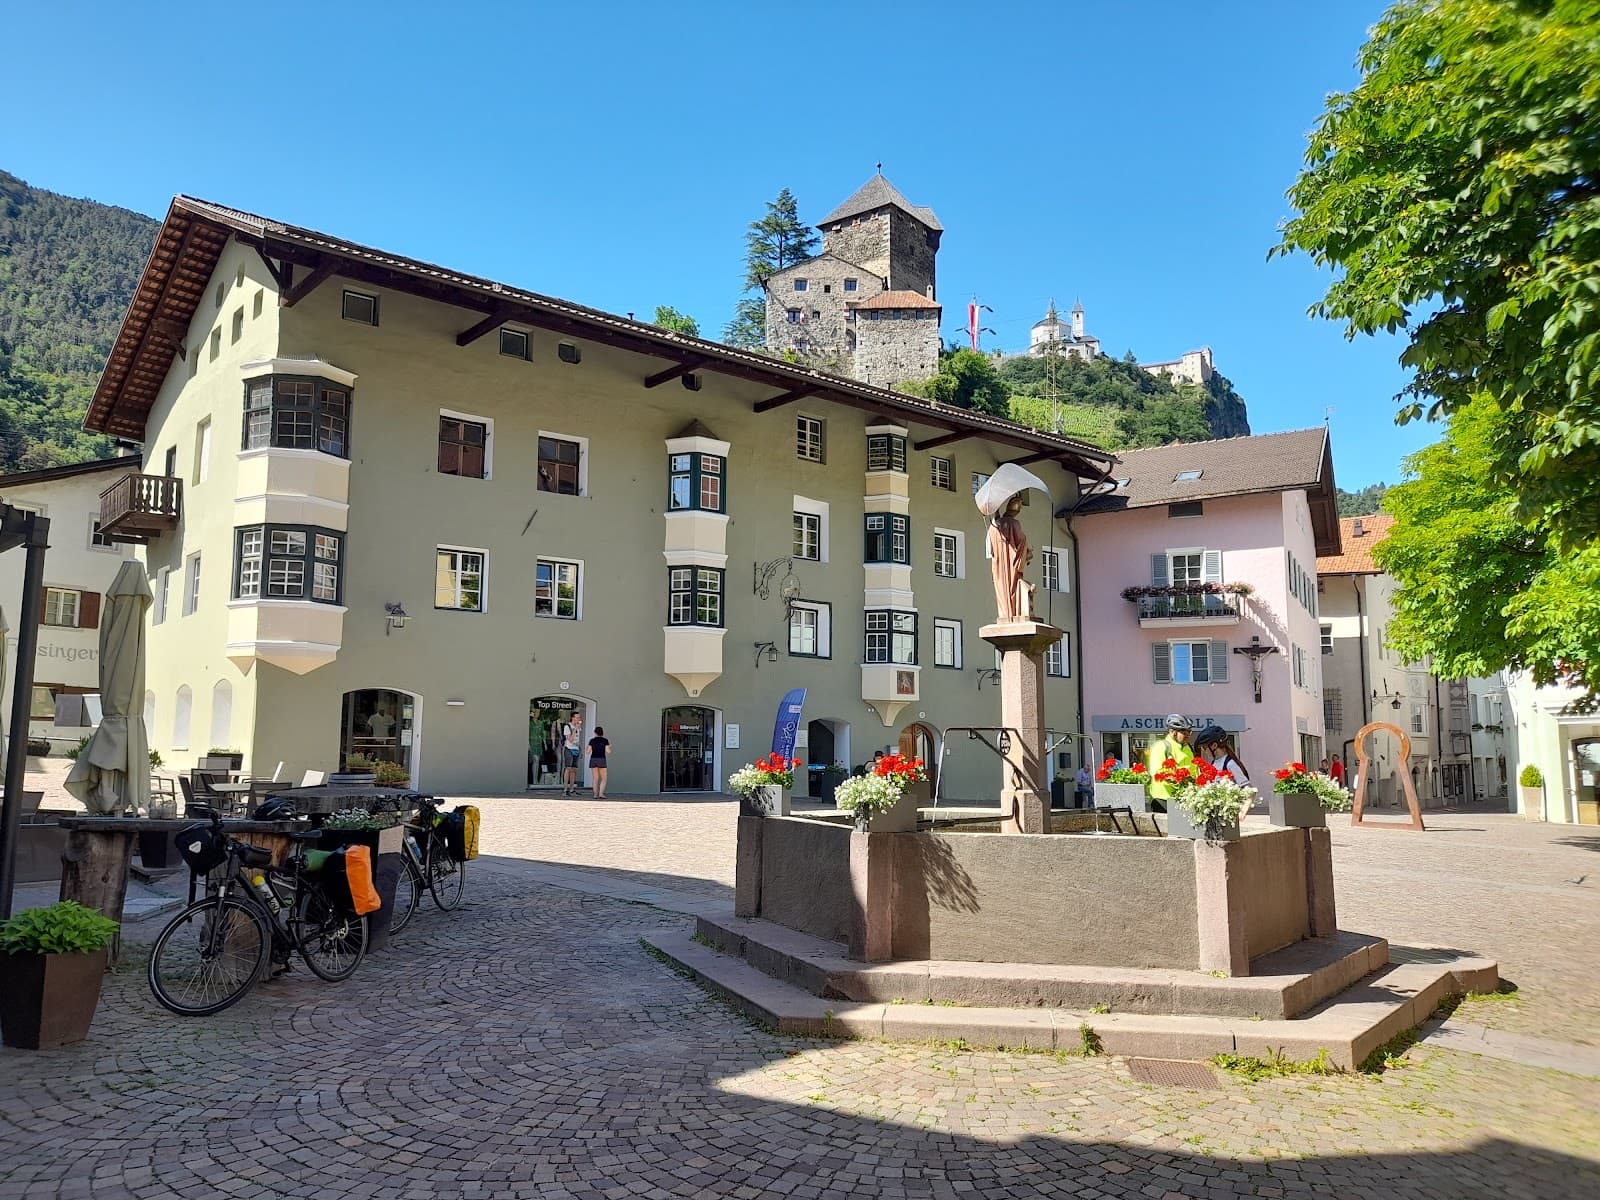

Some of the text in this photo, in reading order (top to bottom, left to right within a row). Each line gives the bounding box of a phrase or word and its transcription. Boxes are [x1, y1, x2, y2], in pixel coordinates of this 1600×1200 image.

[37, 643, 99, 661] singer
[536, 700, 572, 709] Top Street
